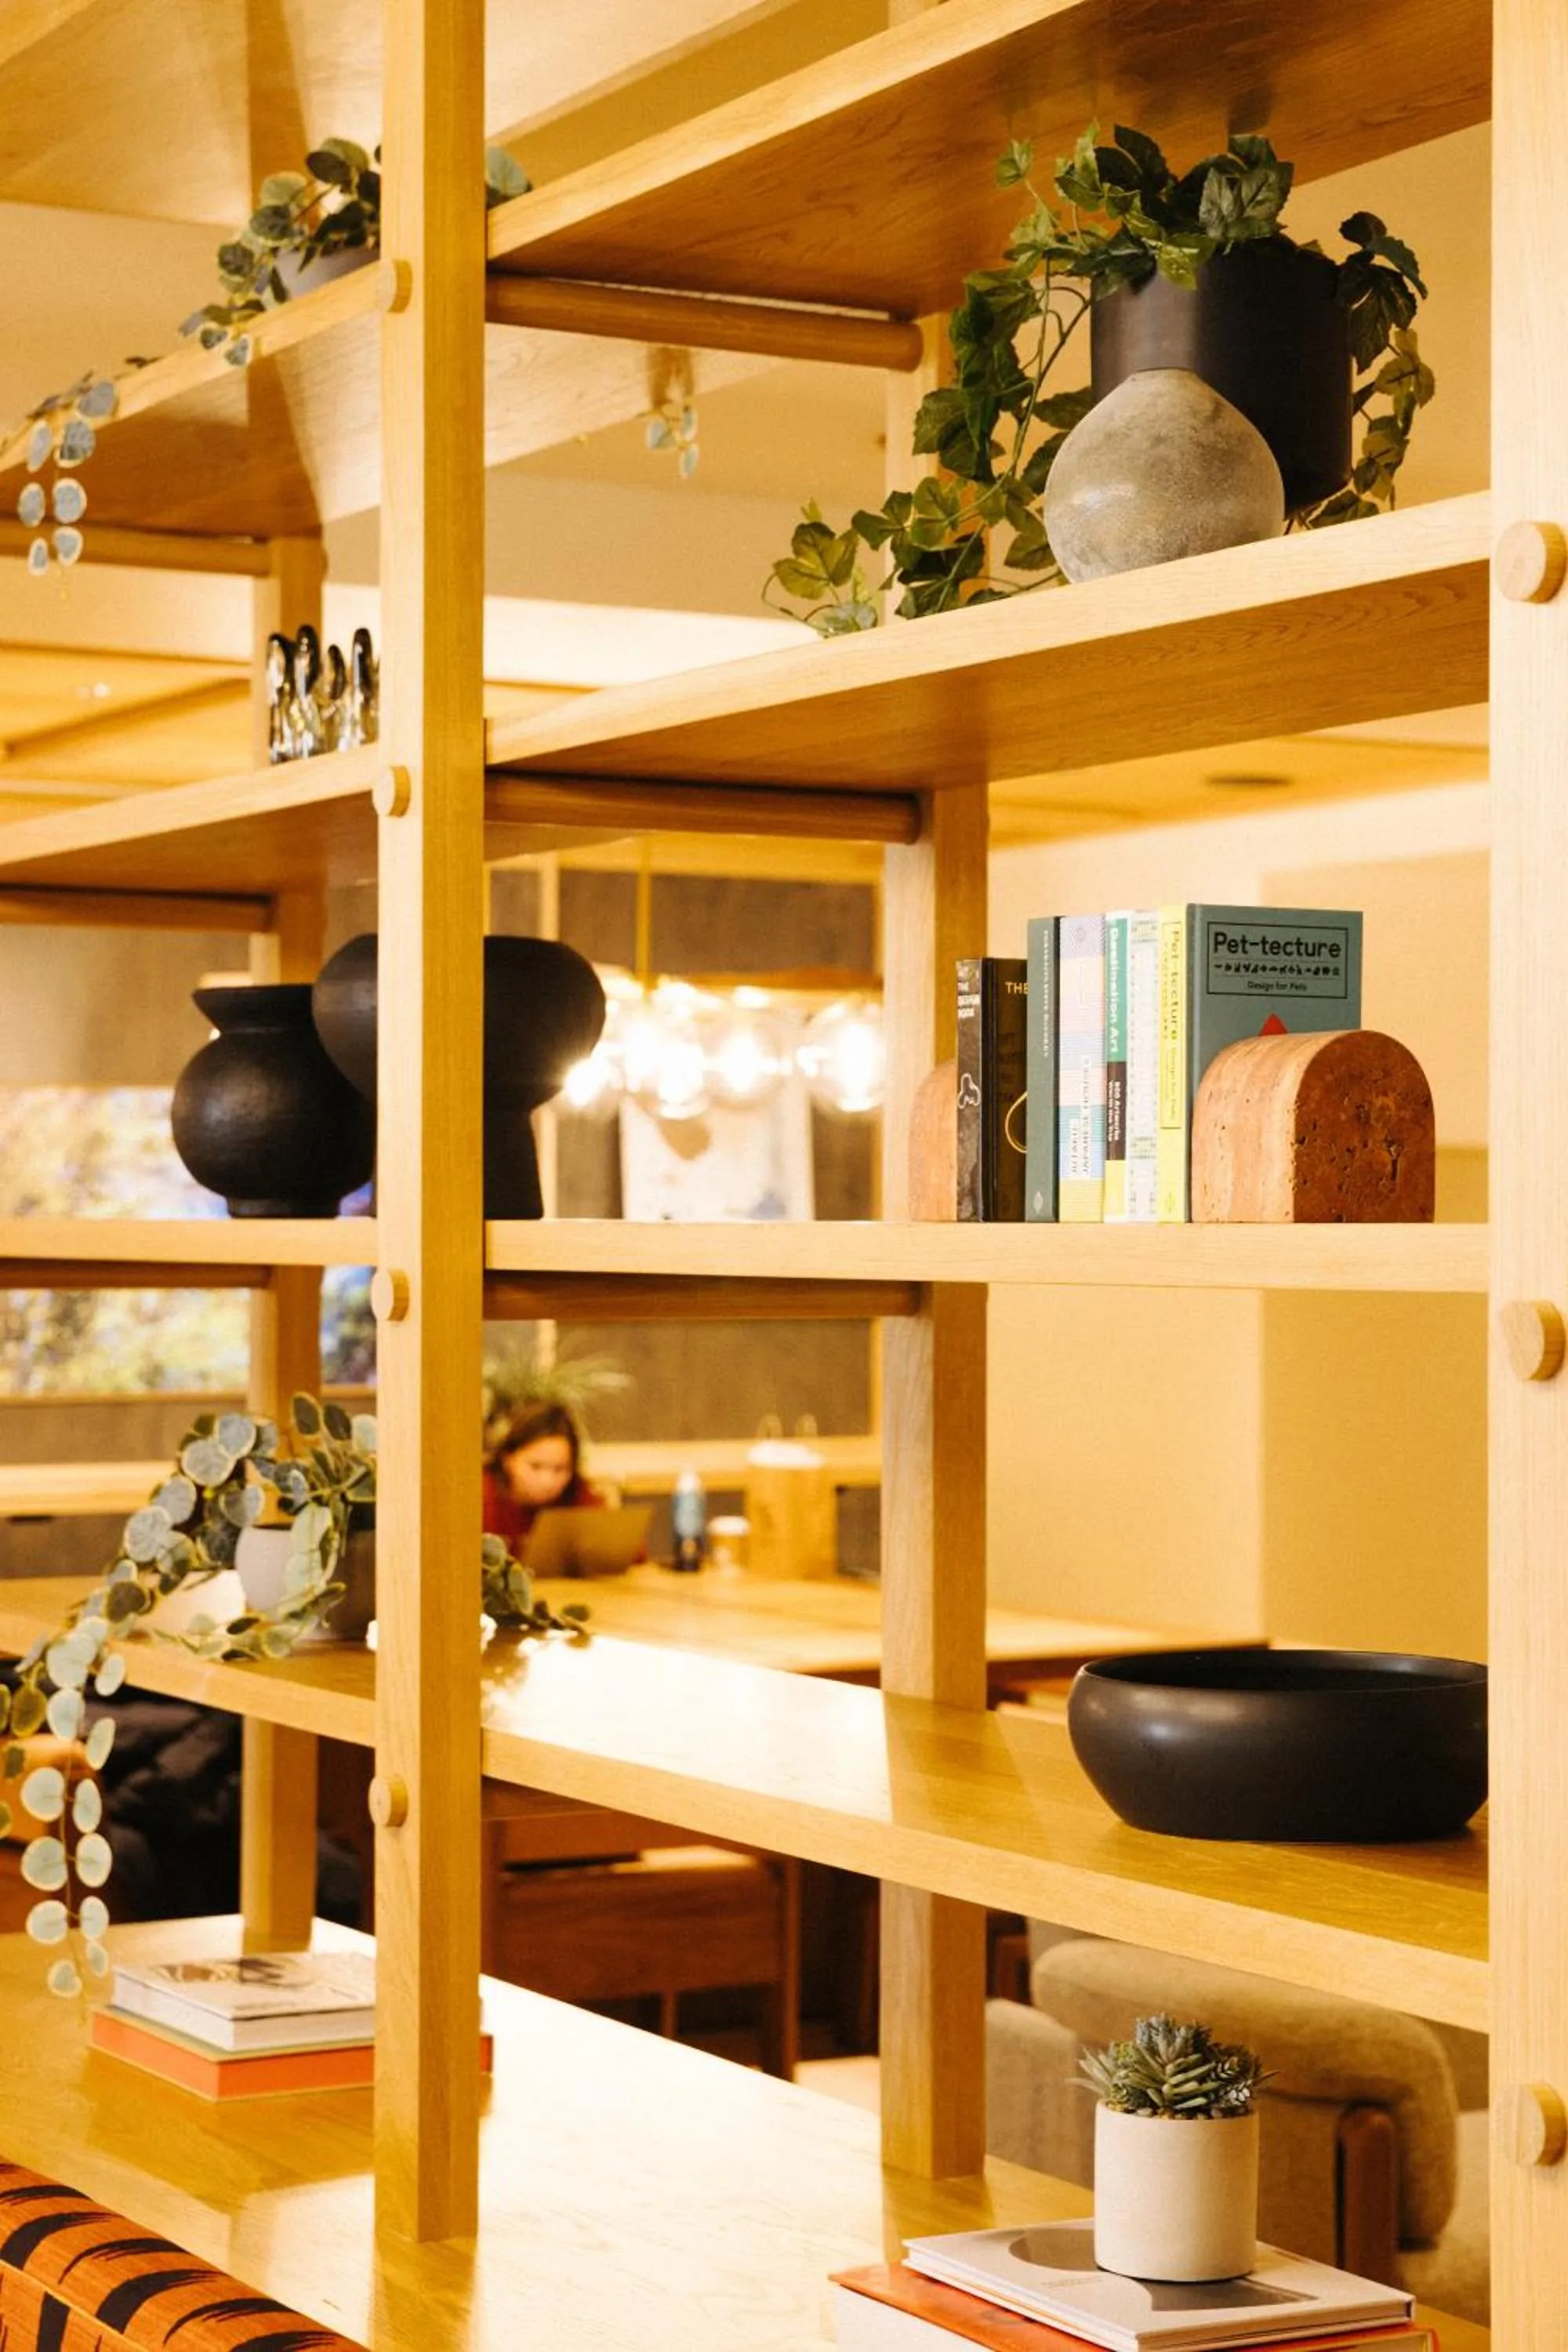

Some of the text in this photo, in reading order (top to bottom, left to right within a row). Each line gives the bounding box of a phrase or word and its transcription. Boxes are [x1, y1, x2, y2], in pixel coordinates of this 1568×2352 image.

[1214, 931, 1341, 958] Pet-tecture
[1171, 931, 1179, 1040] Pet-tecture
[1247, 981, 1274, 992] Design
[1276, 982, 1287, 990] for
[1109, 1026, 1120, 1053] Art
